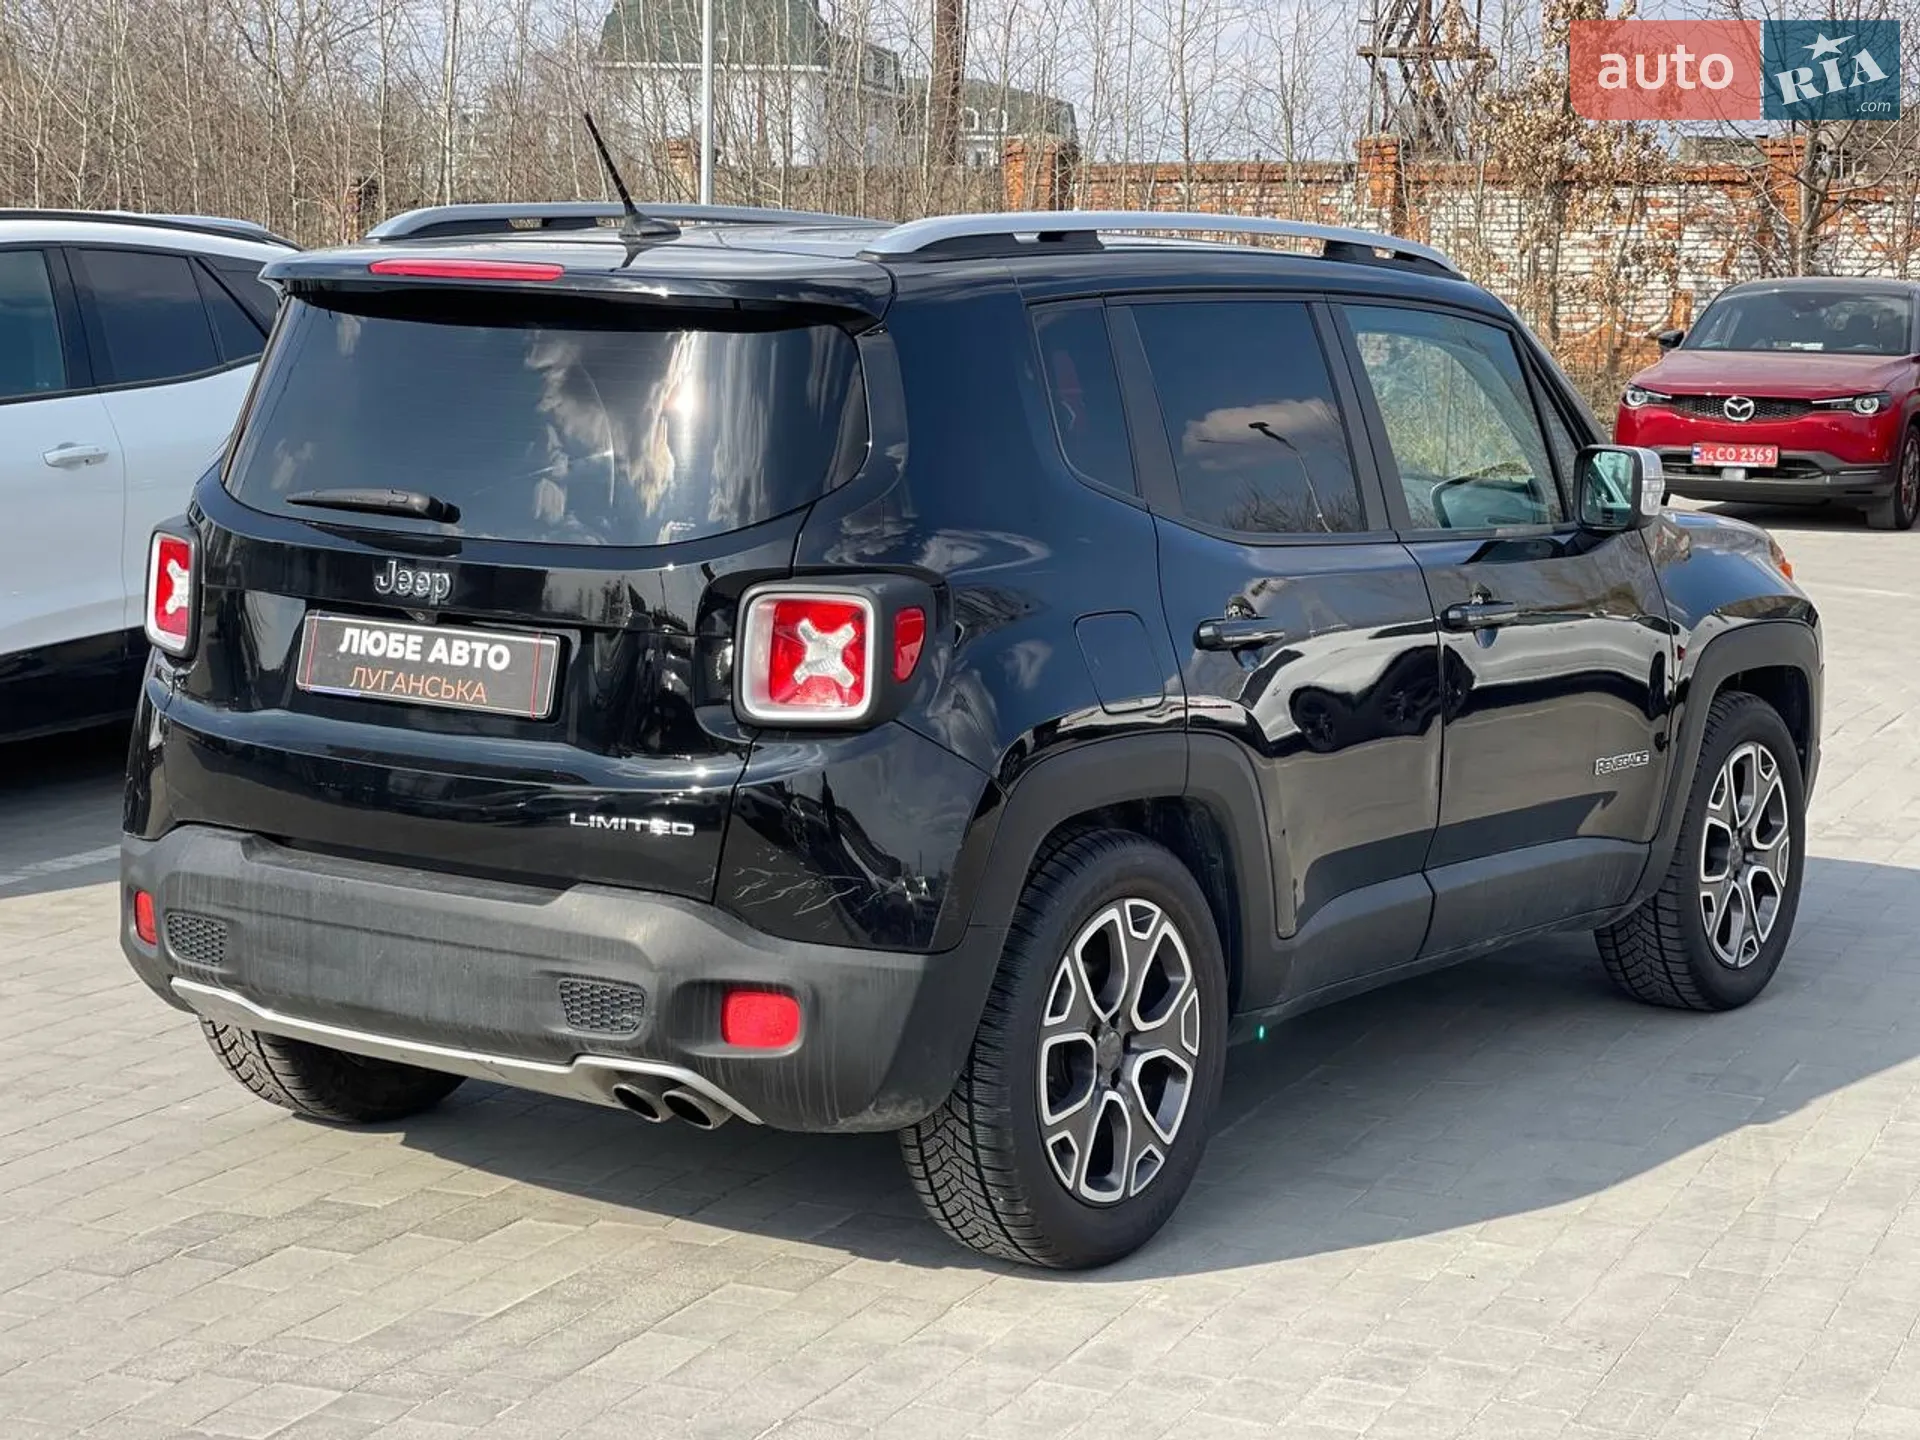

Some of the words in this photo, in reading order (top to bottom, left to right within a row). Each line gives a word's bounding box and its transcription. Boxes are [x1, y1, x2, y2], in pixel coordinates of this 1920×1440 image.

[1740, 447, 1773, 462] 2369
[374, 560, 452, 605] Jeep
[339, 627, 423, 661] ЛЮБЕ
[427, 637, 511, 671] АВТО
[350, 666, 488, 704] ЛУГАНСЬКА
[569, 812, 695, 837] LIMITED
